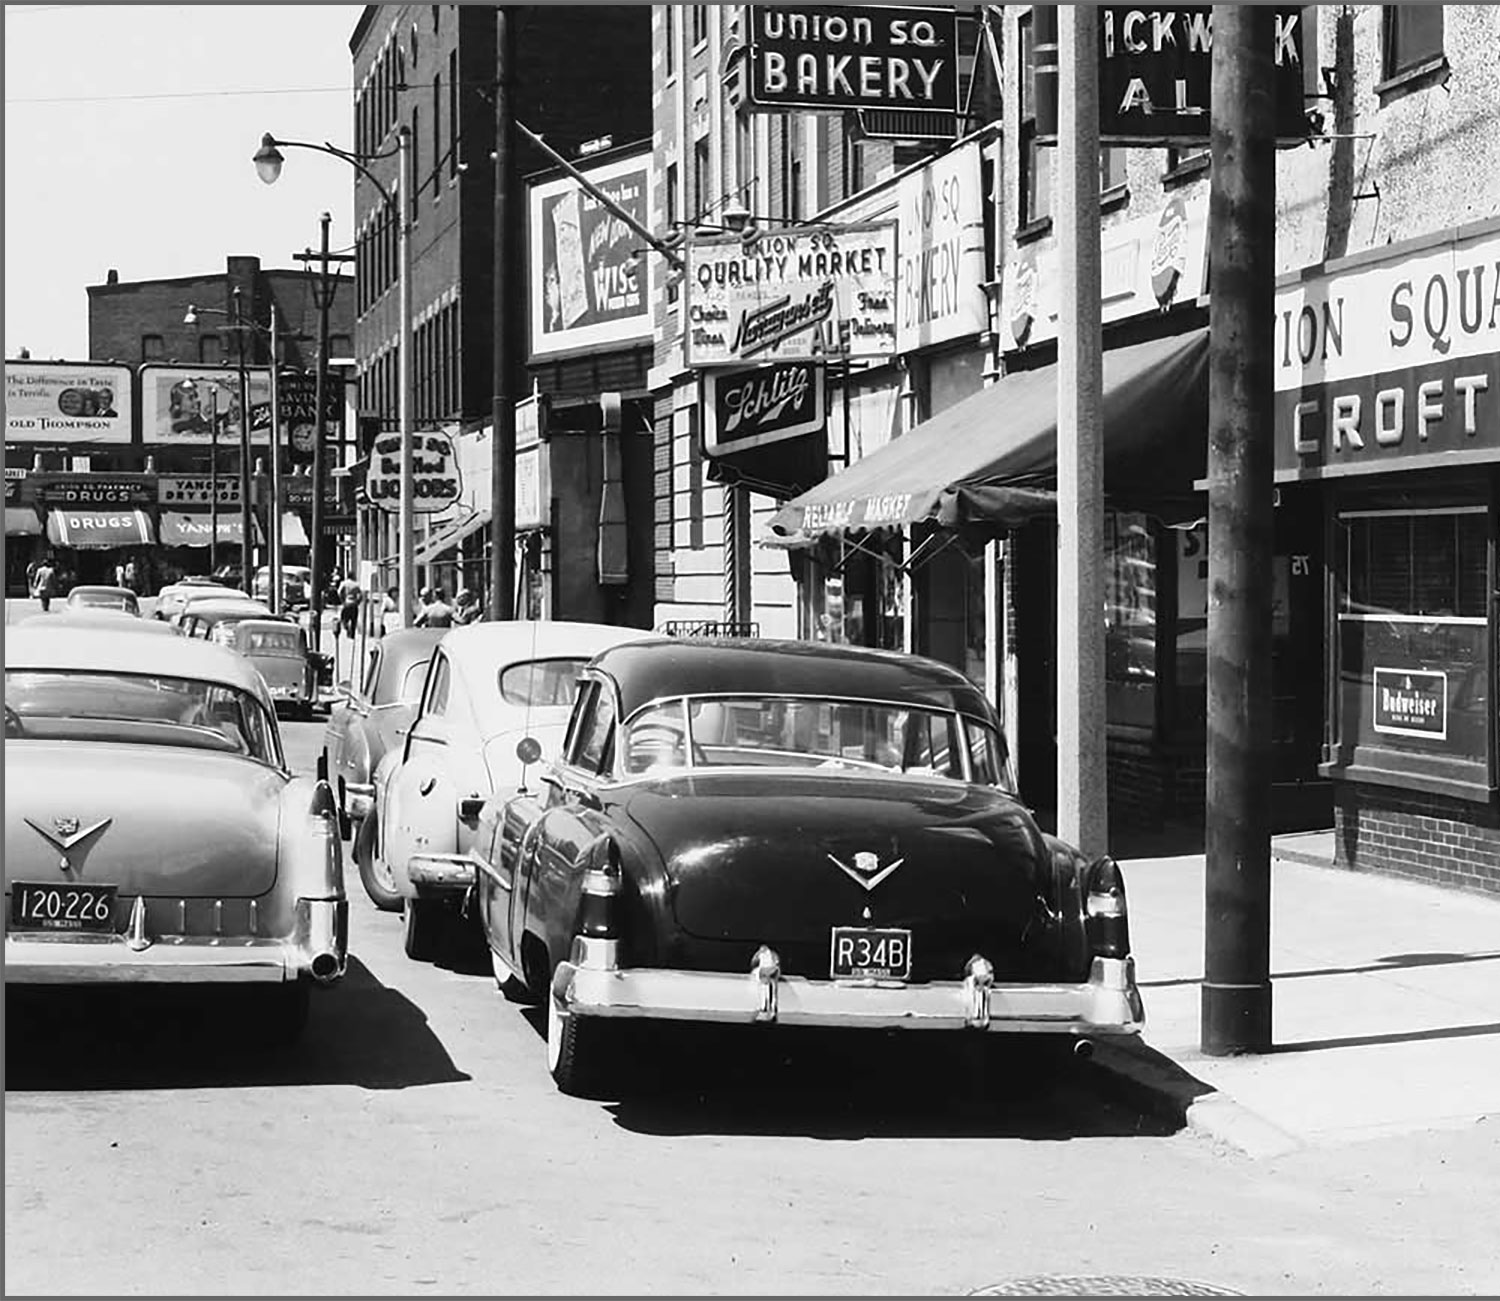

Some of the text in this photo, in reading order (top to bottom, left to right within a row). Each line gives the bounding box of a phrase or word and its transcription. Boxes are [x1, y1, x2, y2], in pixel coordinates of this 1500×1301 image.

[764, 51, 946, 100] BAKERY
[697, 247, 886, 293] QUALITY MARKET
[811, 319, 850, 356] ALE
[725, 366, 809, 432] Schlitz
[1294, 373, 1489, 454] CROFT
[10, 419, 36, 428] OLD
[66, 491, 131, 502] DRUGS
[166, 491, 195, 500] DRY
[863, 494, 913, 522] MARKET
[69, 516, 133, 529] DRUGS
[1383, 687, 1437, 717] Budweiser
[838, 937, 904, 968] R34B
